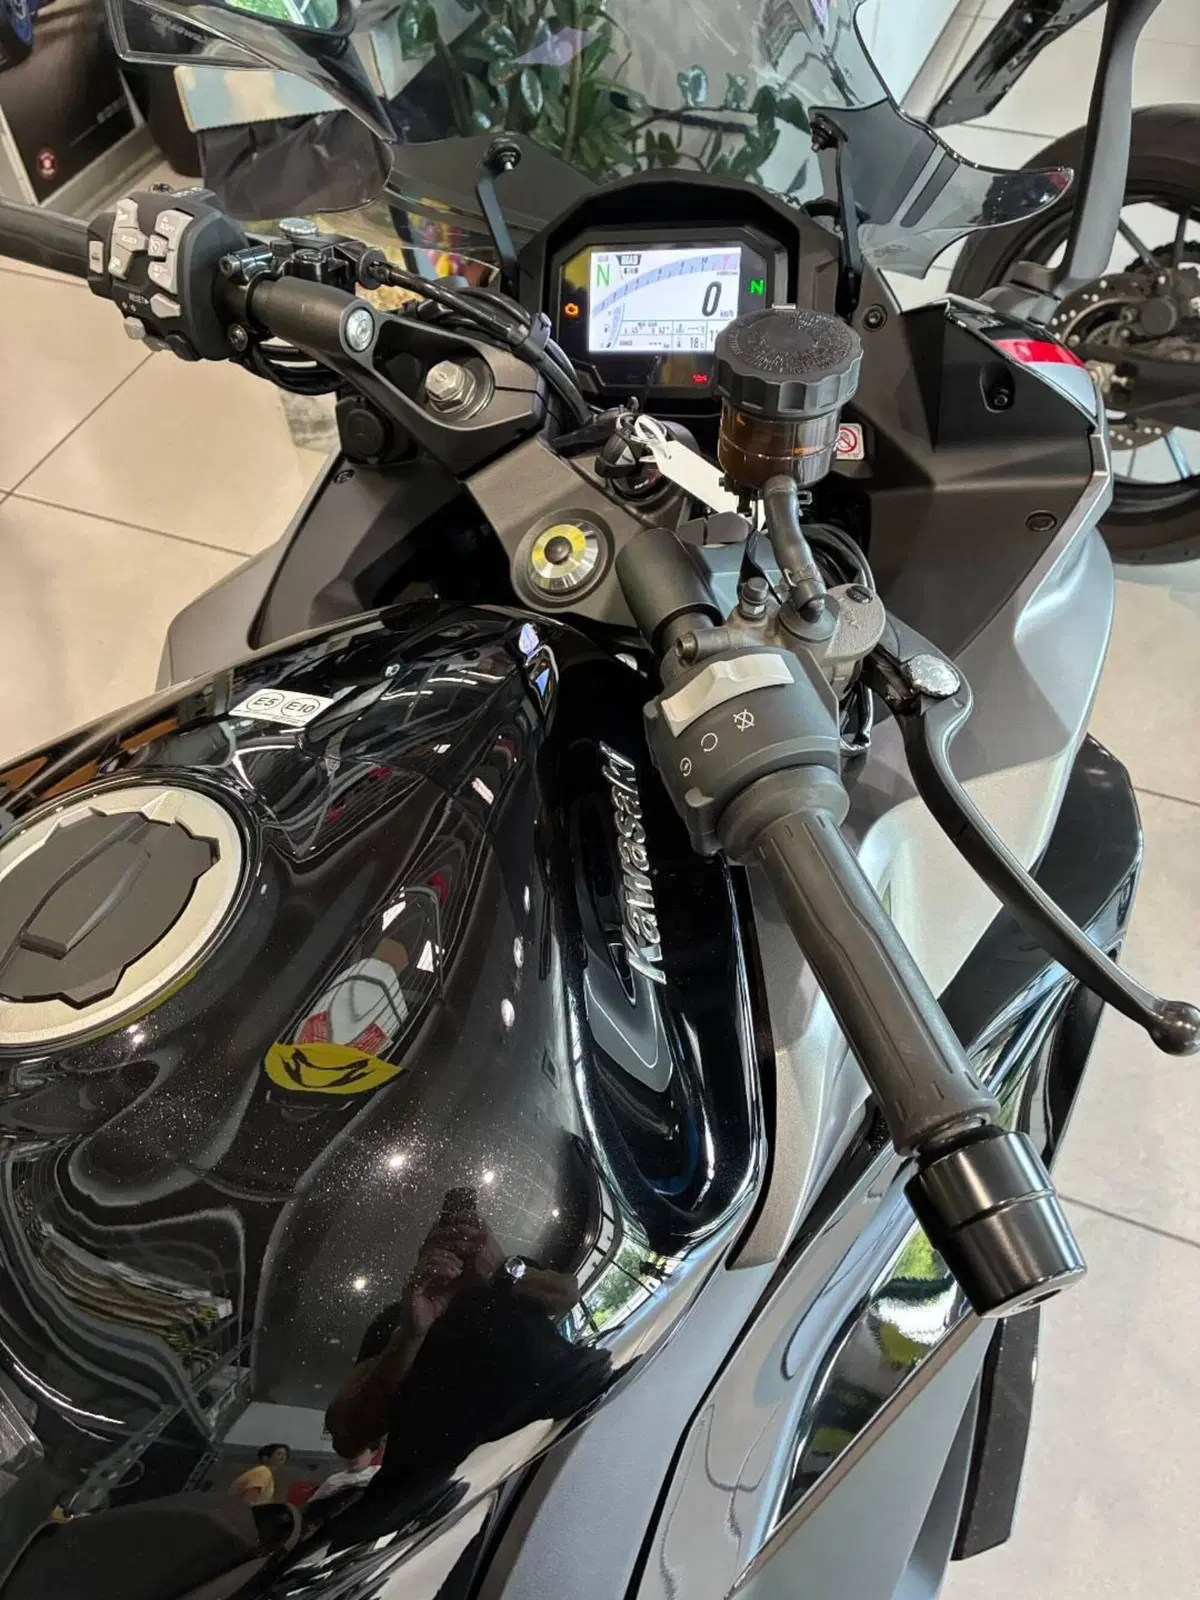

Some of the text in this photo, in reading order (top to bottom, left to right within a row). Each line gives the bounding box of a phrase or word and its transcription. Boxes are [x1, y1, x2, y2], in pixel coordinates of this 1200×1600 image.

[597, 264, 609, 288] N
[750, 279, 764, 295] N
[701, 280, 722, 317] 0
[253, 697, 315, 713] E5 E10
[600, 740, 667, 985] Kawasaki
